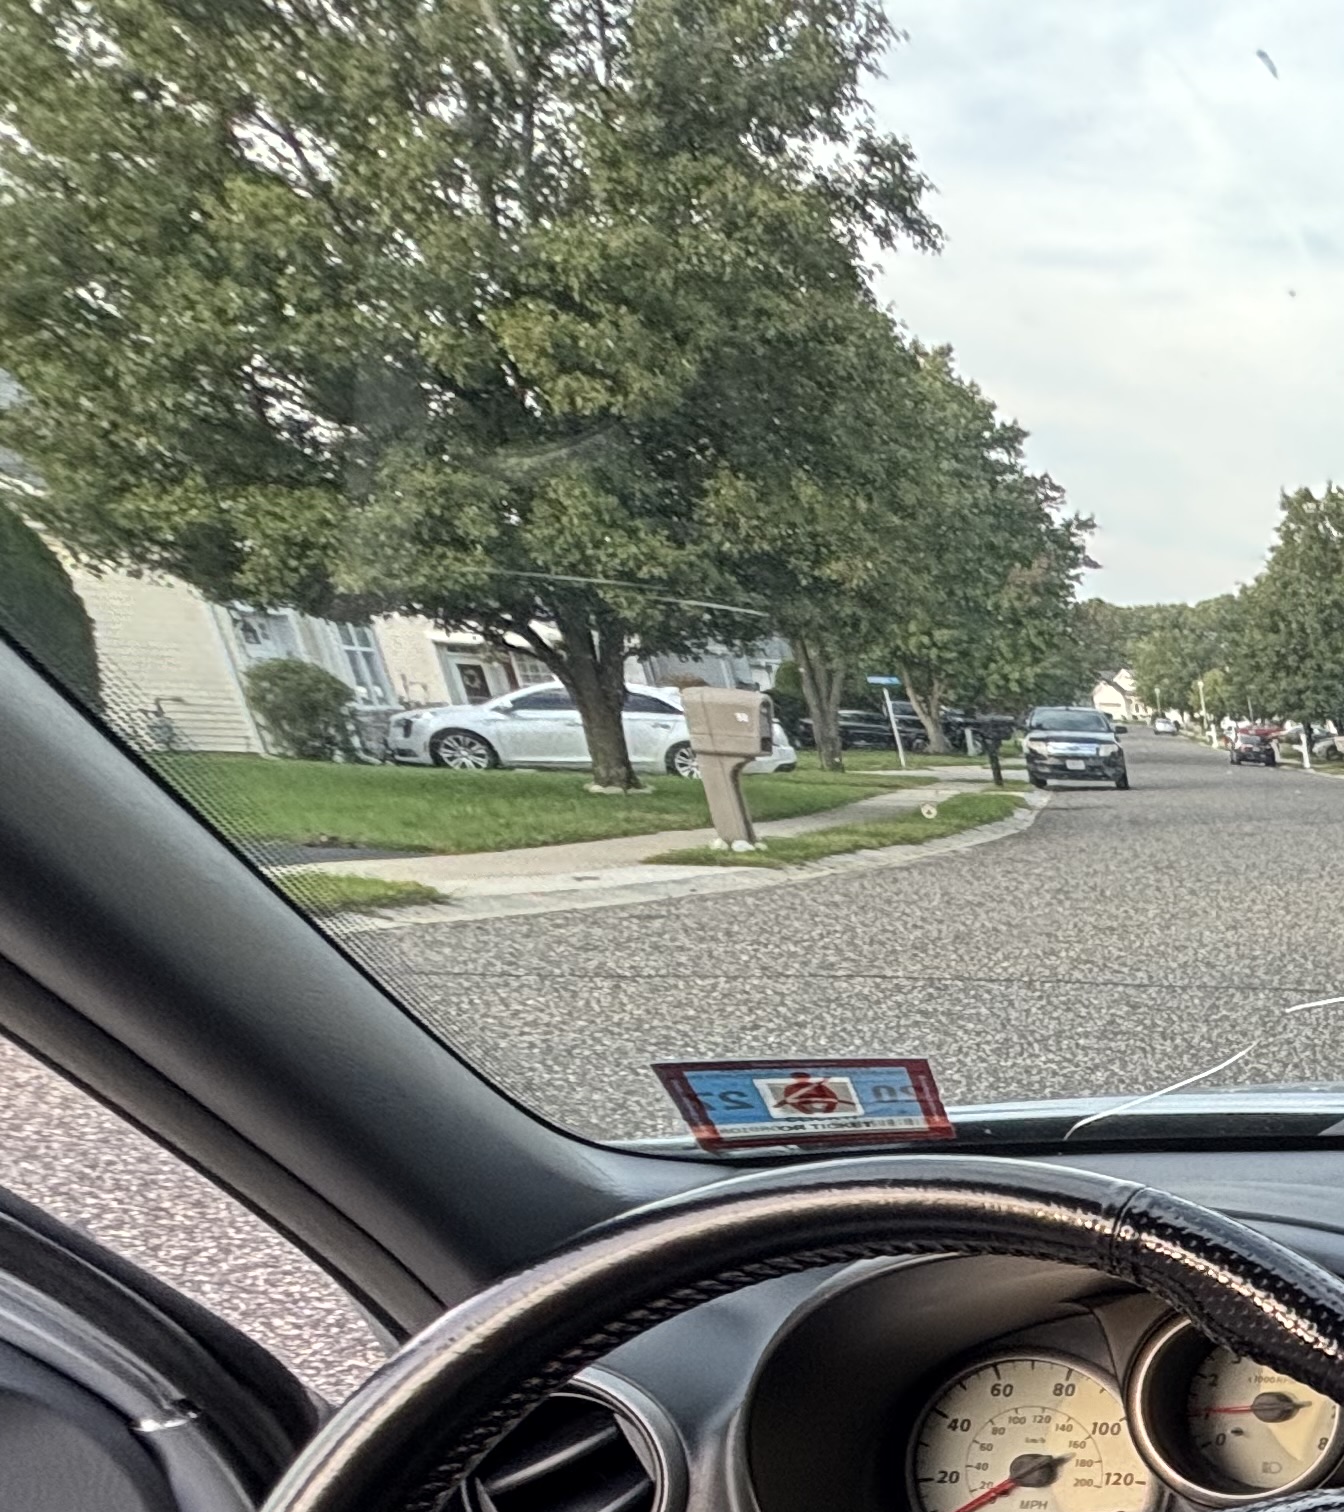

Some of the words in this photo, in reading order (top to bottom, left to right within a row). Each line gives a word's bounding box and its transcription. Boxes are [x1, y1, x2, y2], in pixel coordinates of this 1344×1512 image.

[990, 1383, 1014, 1397] 60
[1052, 1383, 1076, 1397] 80
[1008, 1415, 1027, 1425] 100
[1032, 1414, 1052, 1424] 120
[947, 1418, 971, 1432] 40
[1054, 1423, 1073, 1433] 140
[1091, 1421, 1121, 1436] 100
[991, 1426, 1006, 1436] 80
[1068, 1440, 1087, 1449] 160
[1215, 1433, 1226, 1446] 0
[1317, 1437, 1329, 1450] 8
[979, 1442, 993, 1451] 60
[975, 1462, 989, 1472] 40
[1075, 1458, 1094, 1468] 180
[936, 1470, 960, 1484] 20
[1104, 1472, 1135, 1487] 120
[1073, 1478, 1094, 1488] 200
[1019, 1500, 1048, 1510] MPH
